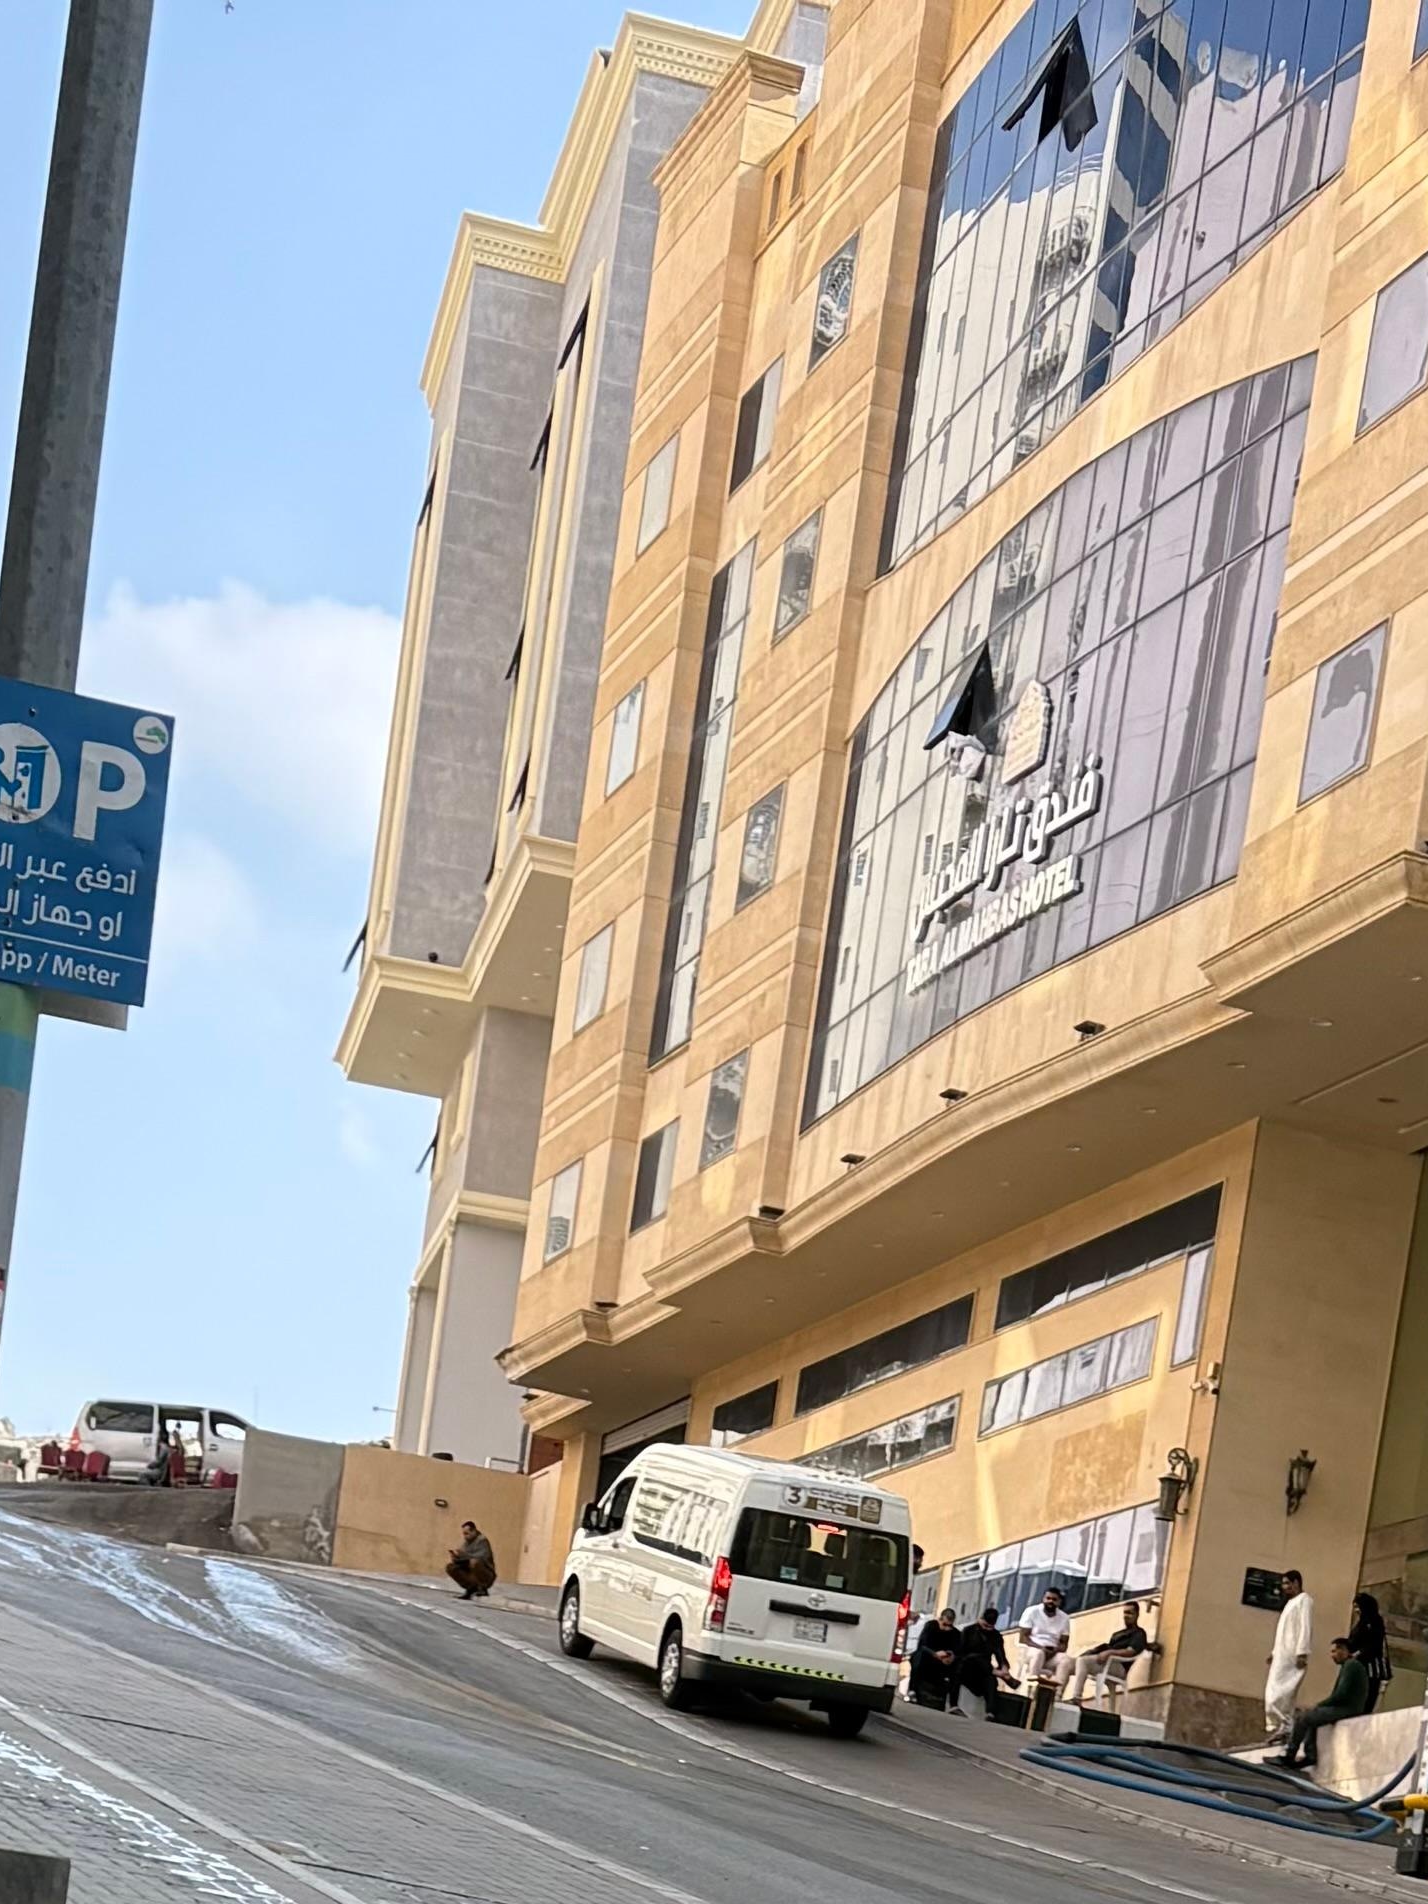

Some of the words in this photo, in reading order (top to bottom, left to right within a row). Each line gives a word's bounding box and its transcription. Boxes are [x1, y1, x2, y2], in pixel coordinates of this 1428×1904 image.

[73, 740, 147, 842] P
[1023, 752, 1102, 864] فندق
[16, 850, 68, 882] عبر
[75, 866, 137, 895] ادفع
[1018, 855, 1078, 919] HOTEL
[21, 893, 93, 937] جهاز
[51, 954, 121, 988] Meter
[787, 1486, 802, 1505] 3
